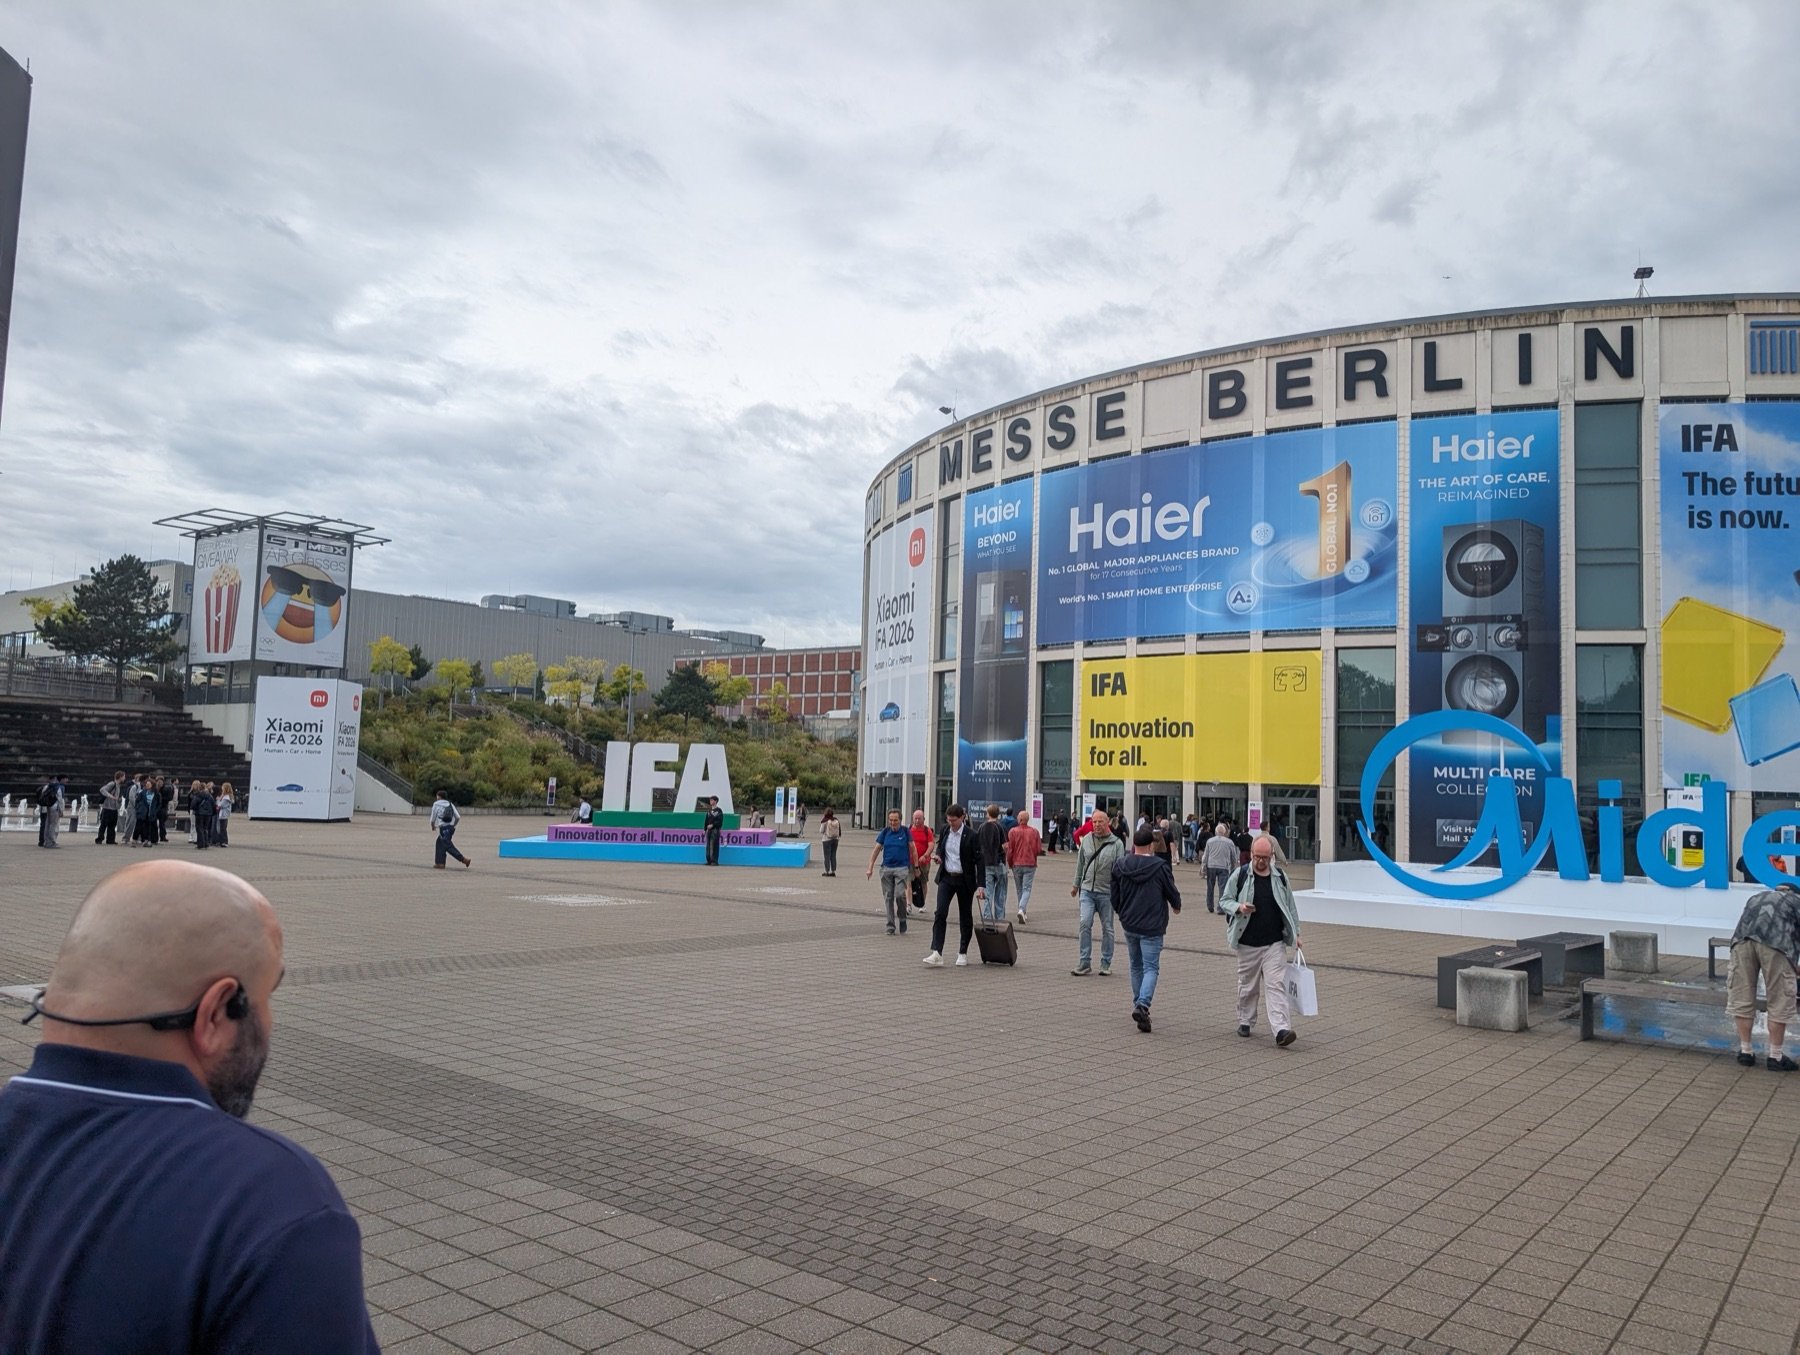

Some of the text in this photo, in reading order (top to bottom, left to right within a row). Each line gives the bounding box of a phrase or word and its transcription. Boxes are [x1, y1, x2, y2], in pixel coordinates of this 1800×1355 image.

[939, 325, 1634, 486] MESSE BERLIN
[1432, 430, 1535, 464] Haier
[1681, 423, 1739, 453] IFA
[1418, 472, 1551, 489] THE ART OF CARE,
[1682, 471, 1800, 497] The futu
[1438, 487, 1530, 503] REIMAGINED
[974, 498, 1021, 528] Haier
[1069, 492, 1211, 553] Haier
[1368, 512, 1385, 523] IoT
[1688, 504, 1790, 529] is now.
[977, 530, 1017, 549] BEYOND
[1326, 483, 1338, 574] GLOBAL NO.1
[197, 548, 239, 570] GIVEAWAY
[265, 547, 346, 572] AR Glasses
[976, 544, 1017, 560] WHAT YOU SEE
[1048, 567, 1060, 576] No.
[1067, 561, 1100, 574] GLOBAL
[1103, 557, 1136, 569] MAJOR
[1137, 550, 1199, 565] APPLIANCES
[1201, 546, 1240, 558] BRAND
[1090, 564, 1183, 581] for 17 Consecutive Years
[876, 582, 915, 625] Xiaomi
[1059, 594, 1086, 605] World's
[1087, 594, 1100, 602] No.
[1106, 589, 1135, 600] SMART
[1136, 586, 1164, 597] HOME
[1165, 581, 1223, 593] ENTERPRISE
[875, 618, 914, 651] IFA 2026
[1091, 671, 1127, 697] IFA
[265, 717, 324, 733] Xiaomi
[1090, 717, 1194, 739] Innovation
[264, 733, 323, 746] IFA 2026
[974, 759, 1012, 771] HORIZON
[1089, 745, 1115, 767] for
[1119, 745, 1148, 767] all.
[601, 740, 735, 814] IFA
[1433, 766, 1484, 779] MULTI
[554, 828, 618, 842] Innovation
[621, 830, 638, 842] for
[640, 830, 657, 843] all.
[725, 832, 743, 844] for
[745, 833, 763, 845] all.
[1442, 825, 1462, 833] Visit
[1443, 834, 1460, 842] Hall
